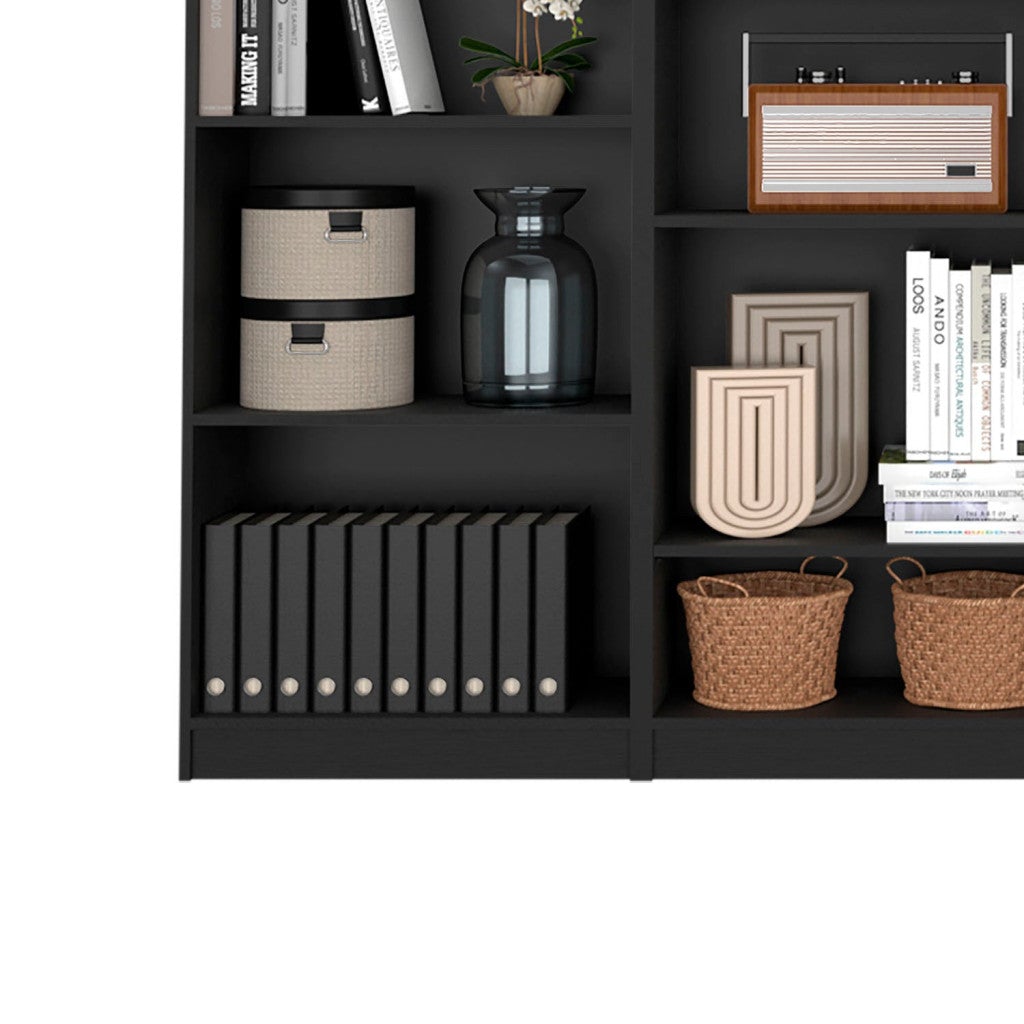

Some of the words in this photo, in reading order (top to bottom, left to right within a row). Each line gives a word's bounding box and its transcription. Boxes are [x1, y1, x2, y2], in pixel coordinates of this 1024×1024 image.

[212, 12, 226, 29] LOS
[240, 33, 258, 48] IT
[240, 51, 258, 106] MAKING
[912, 277, 924, 314] LOOS
[982, 274, 990, 289] THE
[934, 295, 944, 344] ANDO
[954, 283, 964, 334] COMPENDIUM
[981, 293, 990, 334] UNCOMMON
[912, 327, 920, 358] AUGUST
[982, 339, 990, 360] LIFE
[912, 360, 920, 392] SARNITZ
[954, 336, 964, 398] ARCHITECTURAL
[982, 365, 990, 374] OF
[982, 380, 990, 411] COMMON
[954, 400, 964, 438] ANTIQUES
[982, 416, 990, 451] OBJECTS
[895, 490, 907, 498] THE
[908, 490, 921, 498] NEW
[922, 490, 940, 498] YORK
[941, 490, 954, 498] CITY
[954, 490, 974, 498] NOON
[974, 490, 997, 498] PRAYER
[998, 490, 1024, 498] MEETING
